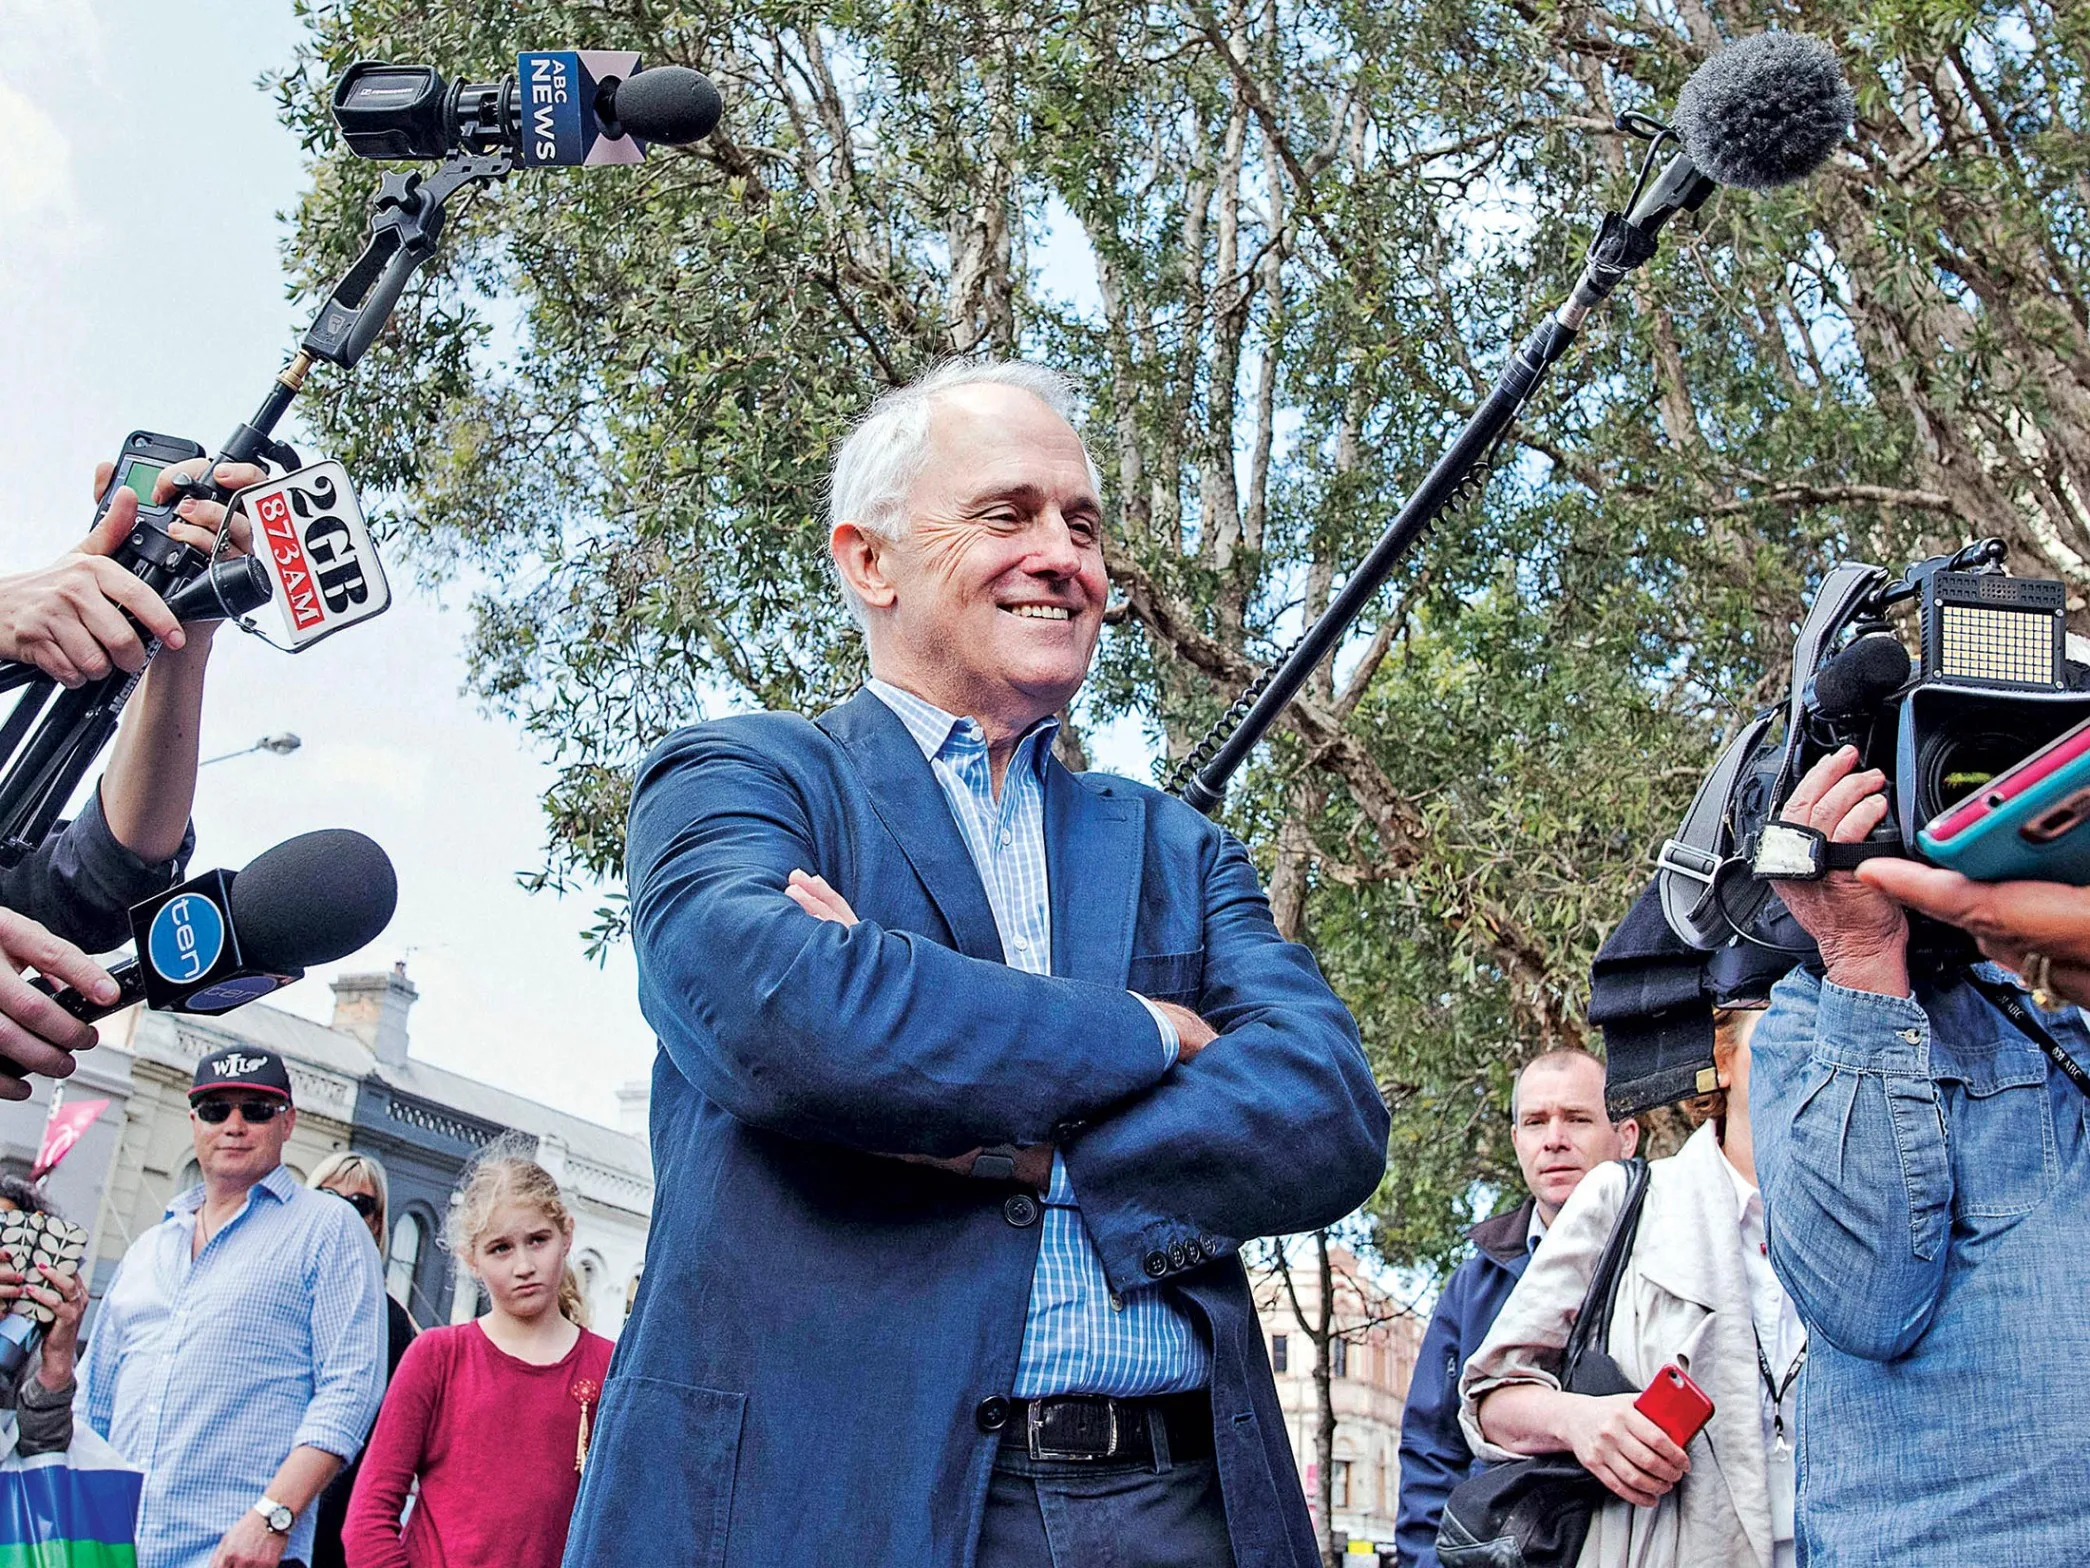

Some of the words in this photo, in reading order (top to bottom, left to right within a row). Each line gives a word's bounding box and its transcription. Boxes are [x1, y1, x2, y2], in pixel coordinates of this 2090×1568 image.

[552, 59, 567, 104] ABC
[531, 59, 556, 160] NEWS
[286, 475, 368, 614] 2GB
[171, 898, 200, 978] ten
[204, 987, 259, 999] ten
[2007, 1002, 2024, 1019] ABC
[2064, 1060, 2082, 1080] ABC
